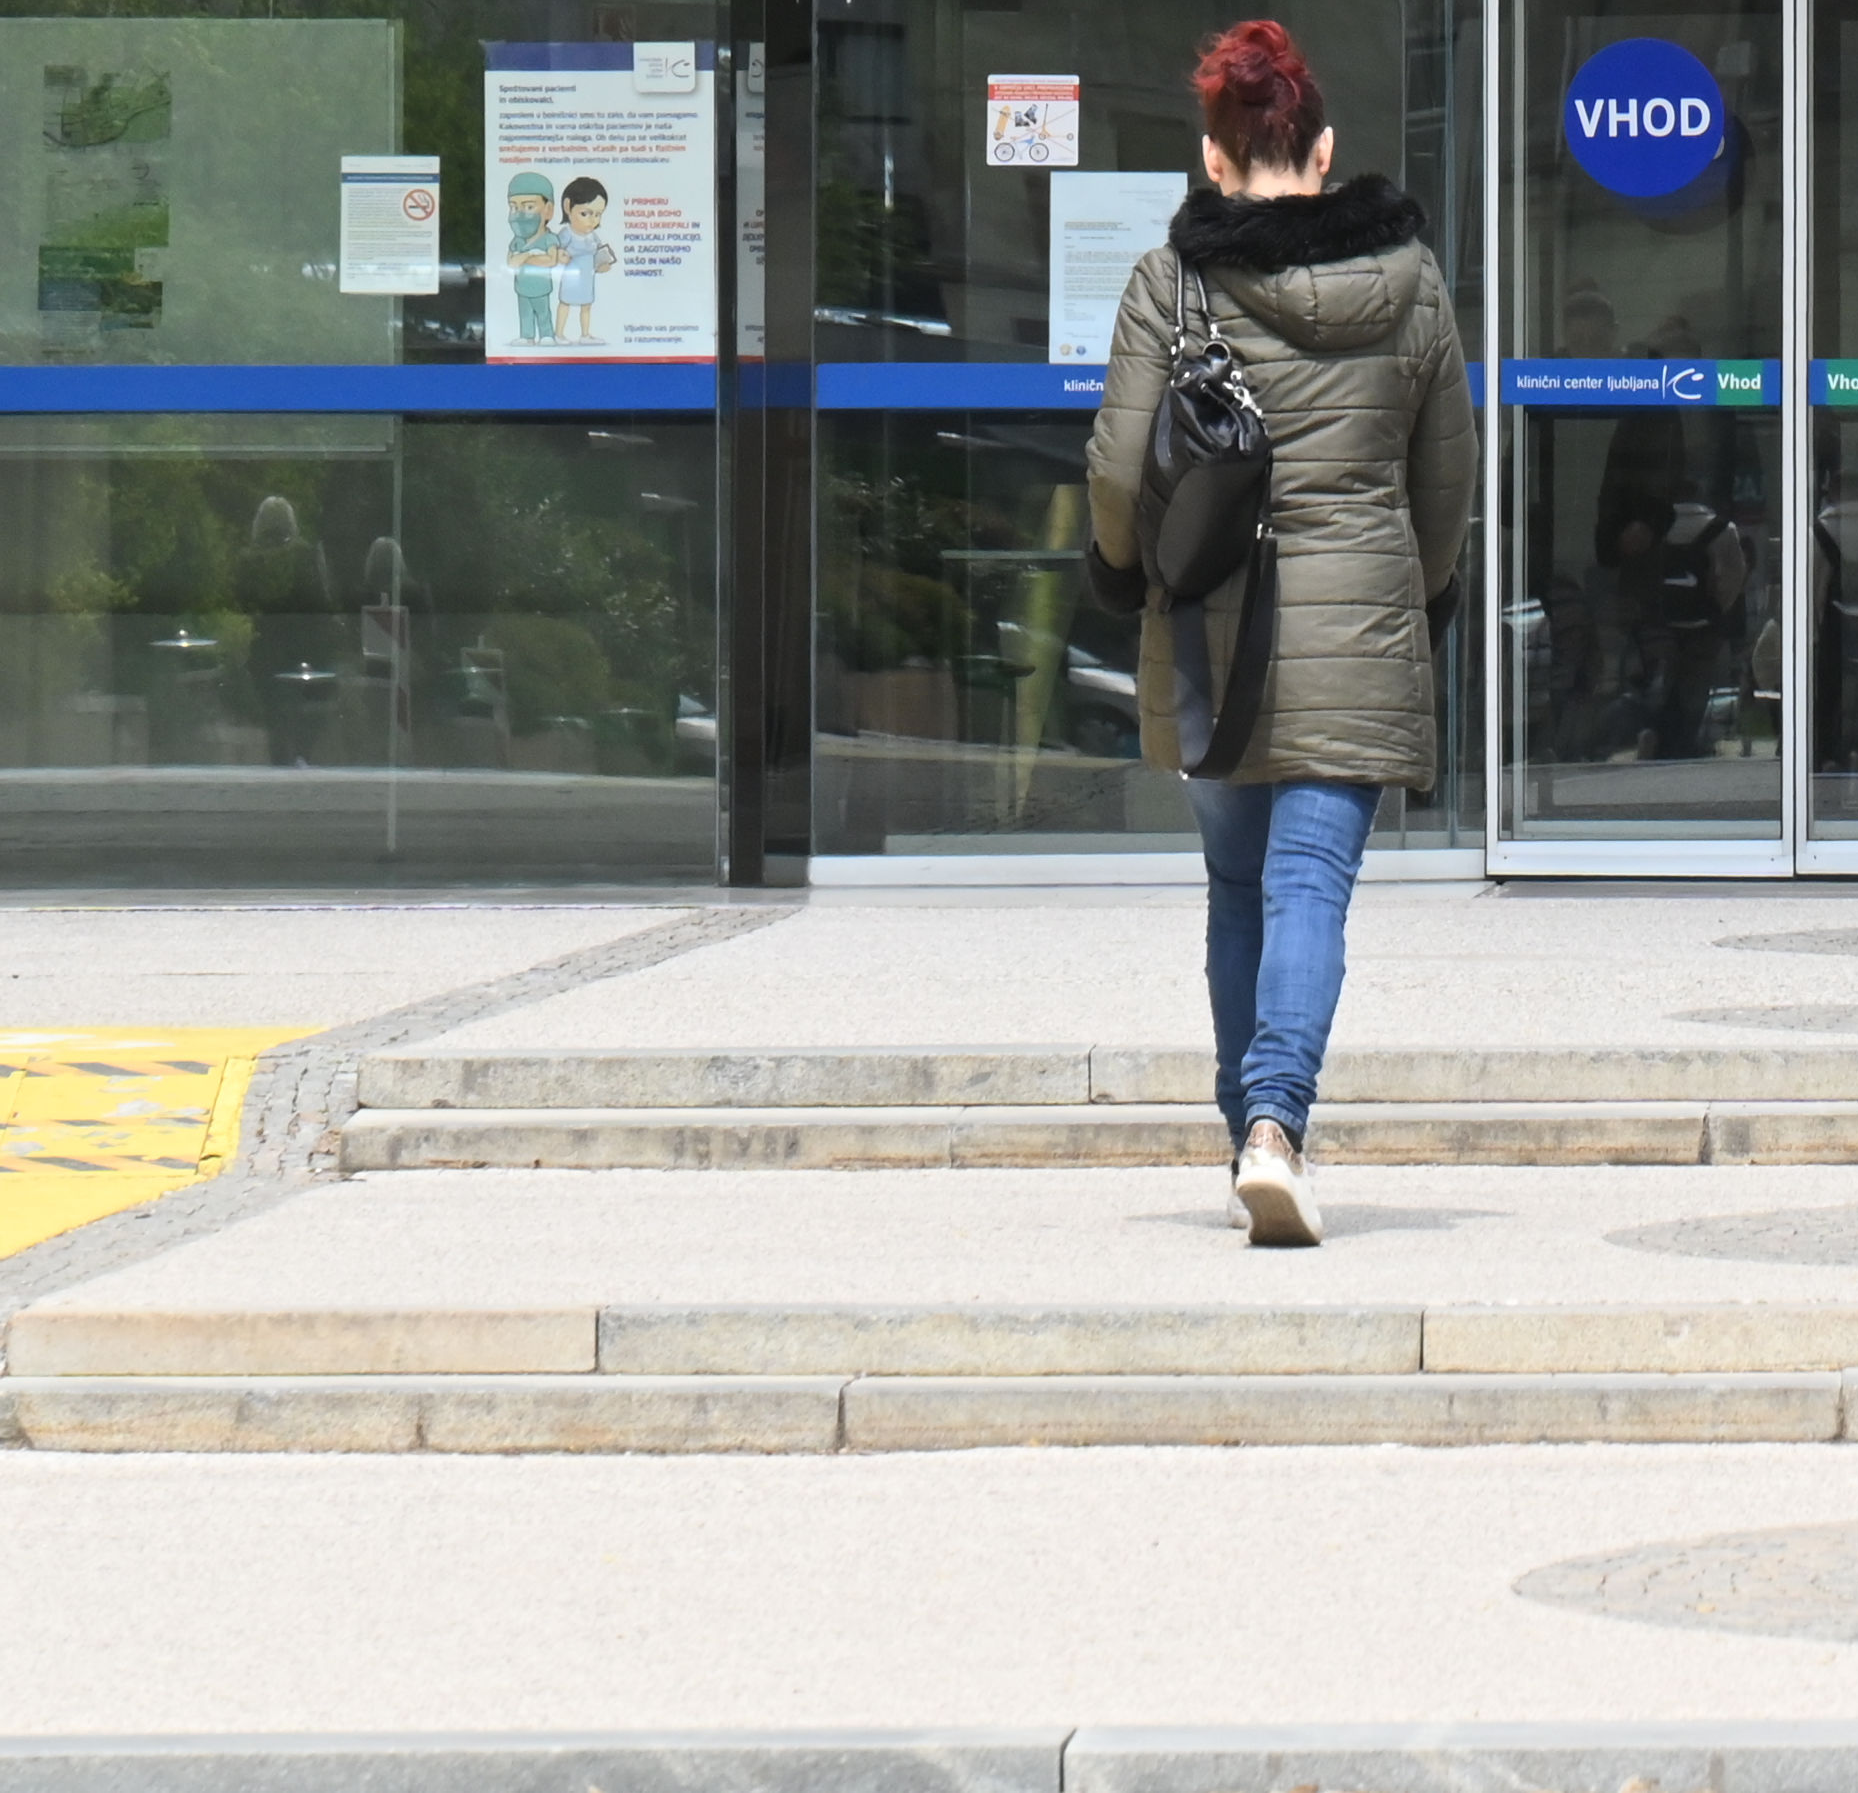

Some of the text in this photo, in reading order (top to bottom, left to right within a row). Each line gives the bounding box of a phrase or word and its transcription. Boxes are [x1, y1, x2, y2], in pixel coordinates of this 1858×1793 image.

[1574, 98, 1711, 138] VHOD
[1064, 379, 1104, 391] kliničn
[1517, 375, 1560, 389] klinični
[1564, 375, 1603, 389] center
[1607, 375, 1659, 391] ljubljana
[1717, 373, 1761, 389] Vhod
